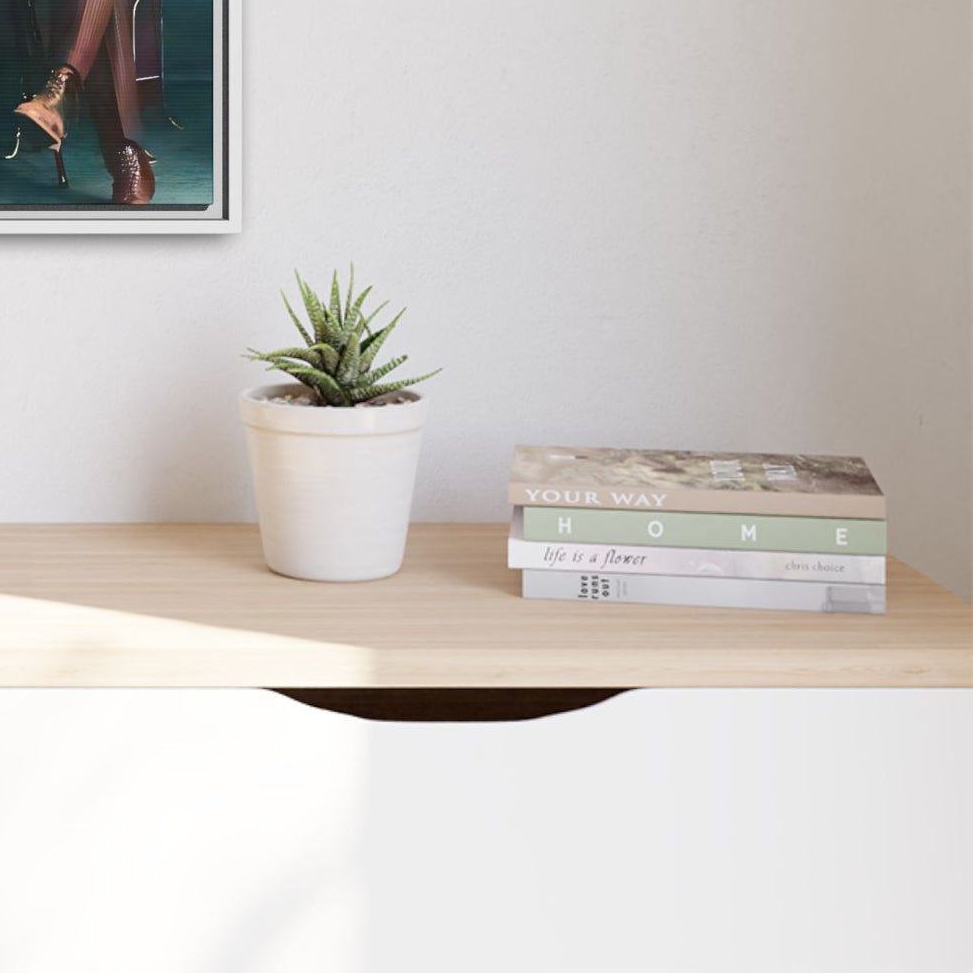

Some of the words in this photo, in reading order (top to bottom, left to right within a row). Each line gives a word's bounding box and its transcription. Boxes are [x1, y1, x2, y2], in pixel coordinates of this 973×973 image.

[525, 489, 600, 504] YOUR
[611, 491, 667, 507] WAY
[543, 547, 566, 567] life
[572, 551, 584, 563] is
[589, 555, 597, 564] a
[600, 549, 647, 568] flower
[785, 561, 809, 572] chris
[812, 561, 845, 573] choice
[578, 575, 588, 598] love
[591, 575, 599, 599] runs
[601, 578, 610, 597] out
